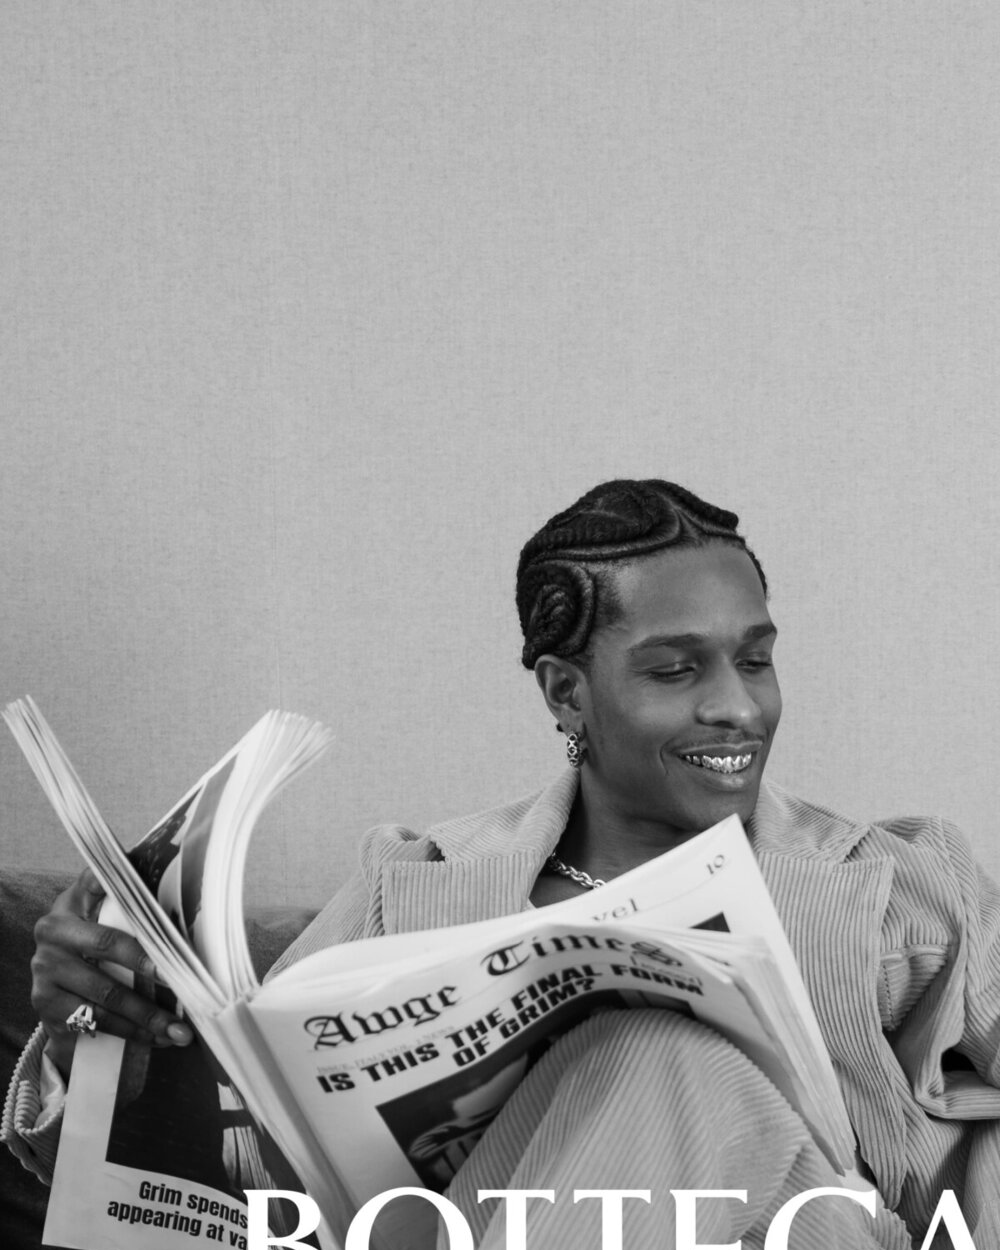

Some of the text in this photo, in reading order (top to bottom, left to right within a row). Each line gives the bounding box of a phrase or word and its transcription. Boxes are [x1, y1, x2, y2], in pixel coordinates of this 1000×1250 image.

[303, 986, 458, 1050] Awge
[316, 1072, 355, 1093] IS
[361, 1043, 440, 1082] THIS
[444, 1008, 505, 1048] THE
[510, 964, 602, 1011] FINAL
[610, 964, 704, 996] FORM
[452, 1035, 490, 1067] OF
[499, 977, 596, 1039] GRIM?
[107, 1200, 202, 1237] appearing
[206, 1222, 225, 1242] at
[139, 1180, 248, 1229] Grim spends
